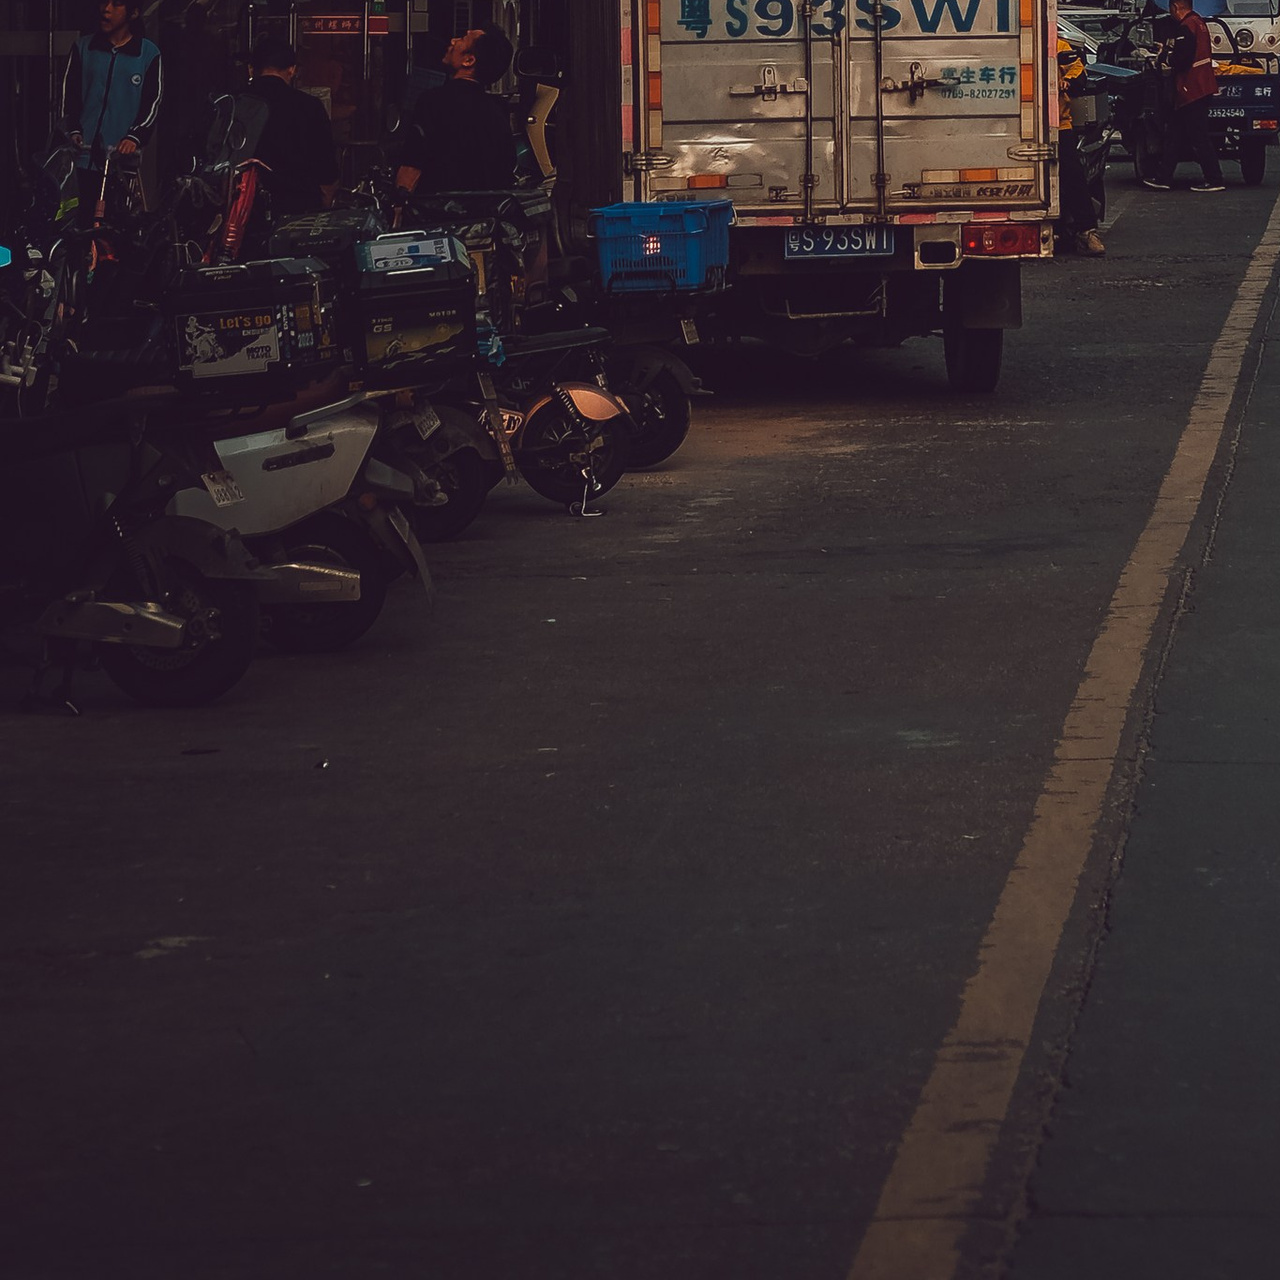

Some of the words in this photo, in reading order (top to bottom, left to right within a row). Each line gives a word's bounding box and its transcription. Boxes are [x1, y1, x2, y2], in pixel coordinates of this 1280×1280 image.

[219, 315, 252, 330] Let's
[254, 314, 272, 328] go
[373, 323, 393, 334] GS
[245, 344, 271, 354] MOTO
[245, 351, 272, 360] TRAVEL
